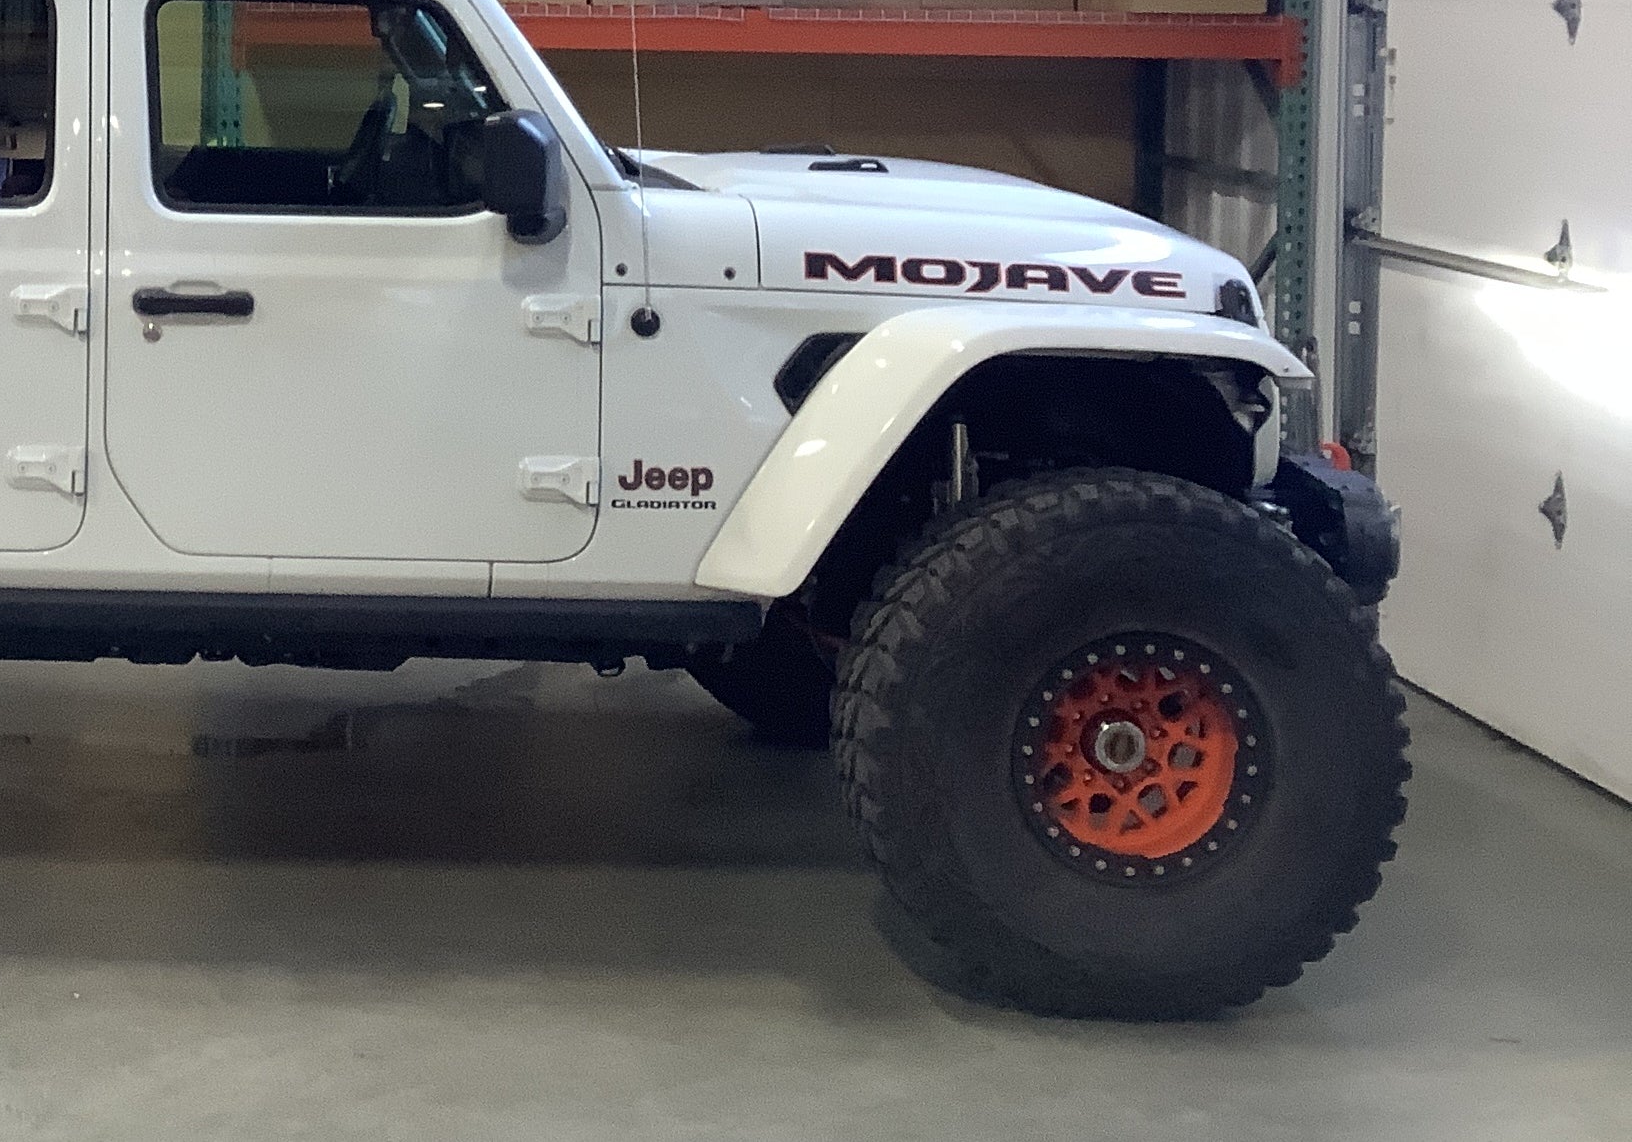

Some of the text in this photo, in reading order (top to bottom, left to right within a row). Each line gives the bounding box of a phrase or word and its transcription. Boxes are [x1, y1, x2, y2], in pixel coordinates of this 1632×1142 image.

[804, 252, 1187, 298] MOJAVE
[618, 459, 714, 497] Jeep
[611, 499, 717, 510] GLADIATOR
